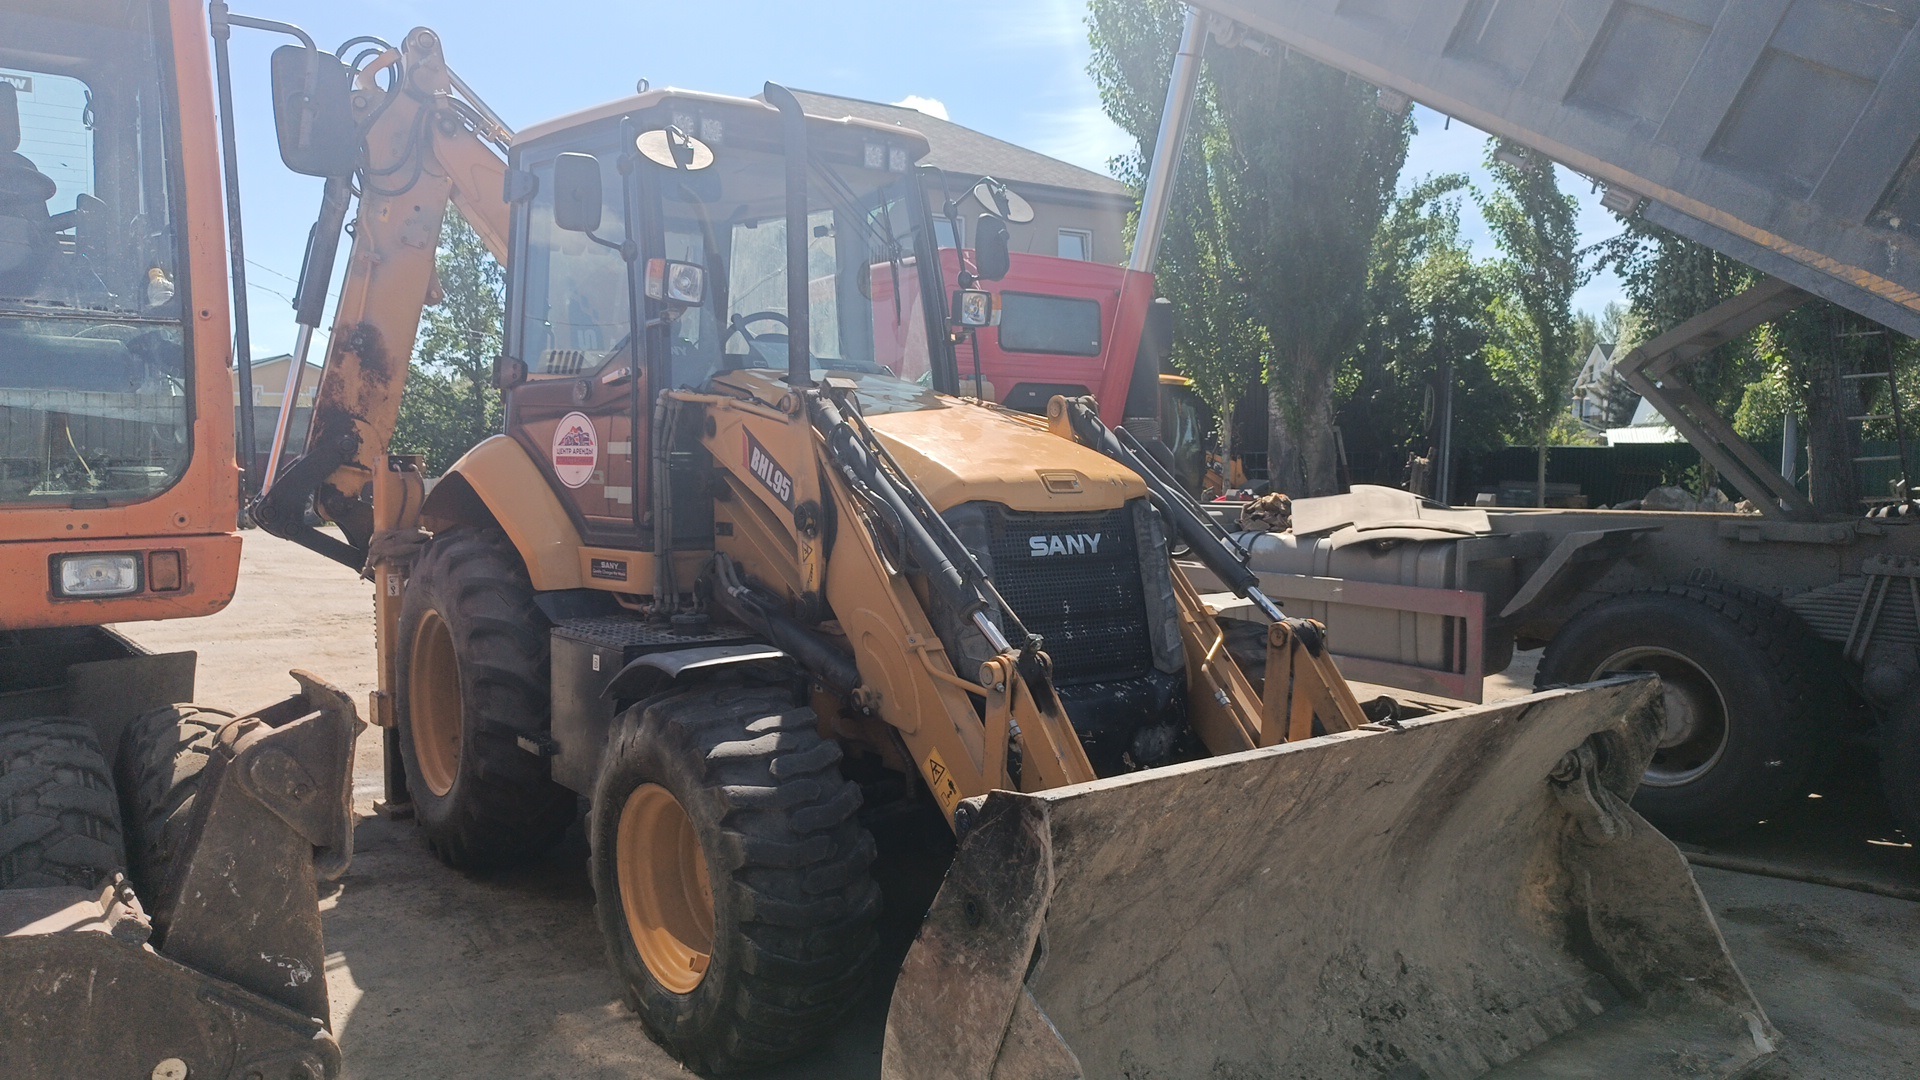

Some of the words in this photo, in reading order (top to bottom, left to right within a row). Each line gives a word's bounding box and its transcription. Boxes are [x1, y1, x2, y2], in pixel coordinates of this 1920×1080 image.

[750, 446, 792, 502] BHL95
[1029, 533, 1101, 557] SANY
[600, 561, 619, 570] SANY
